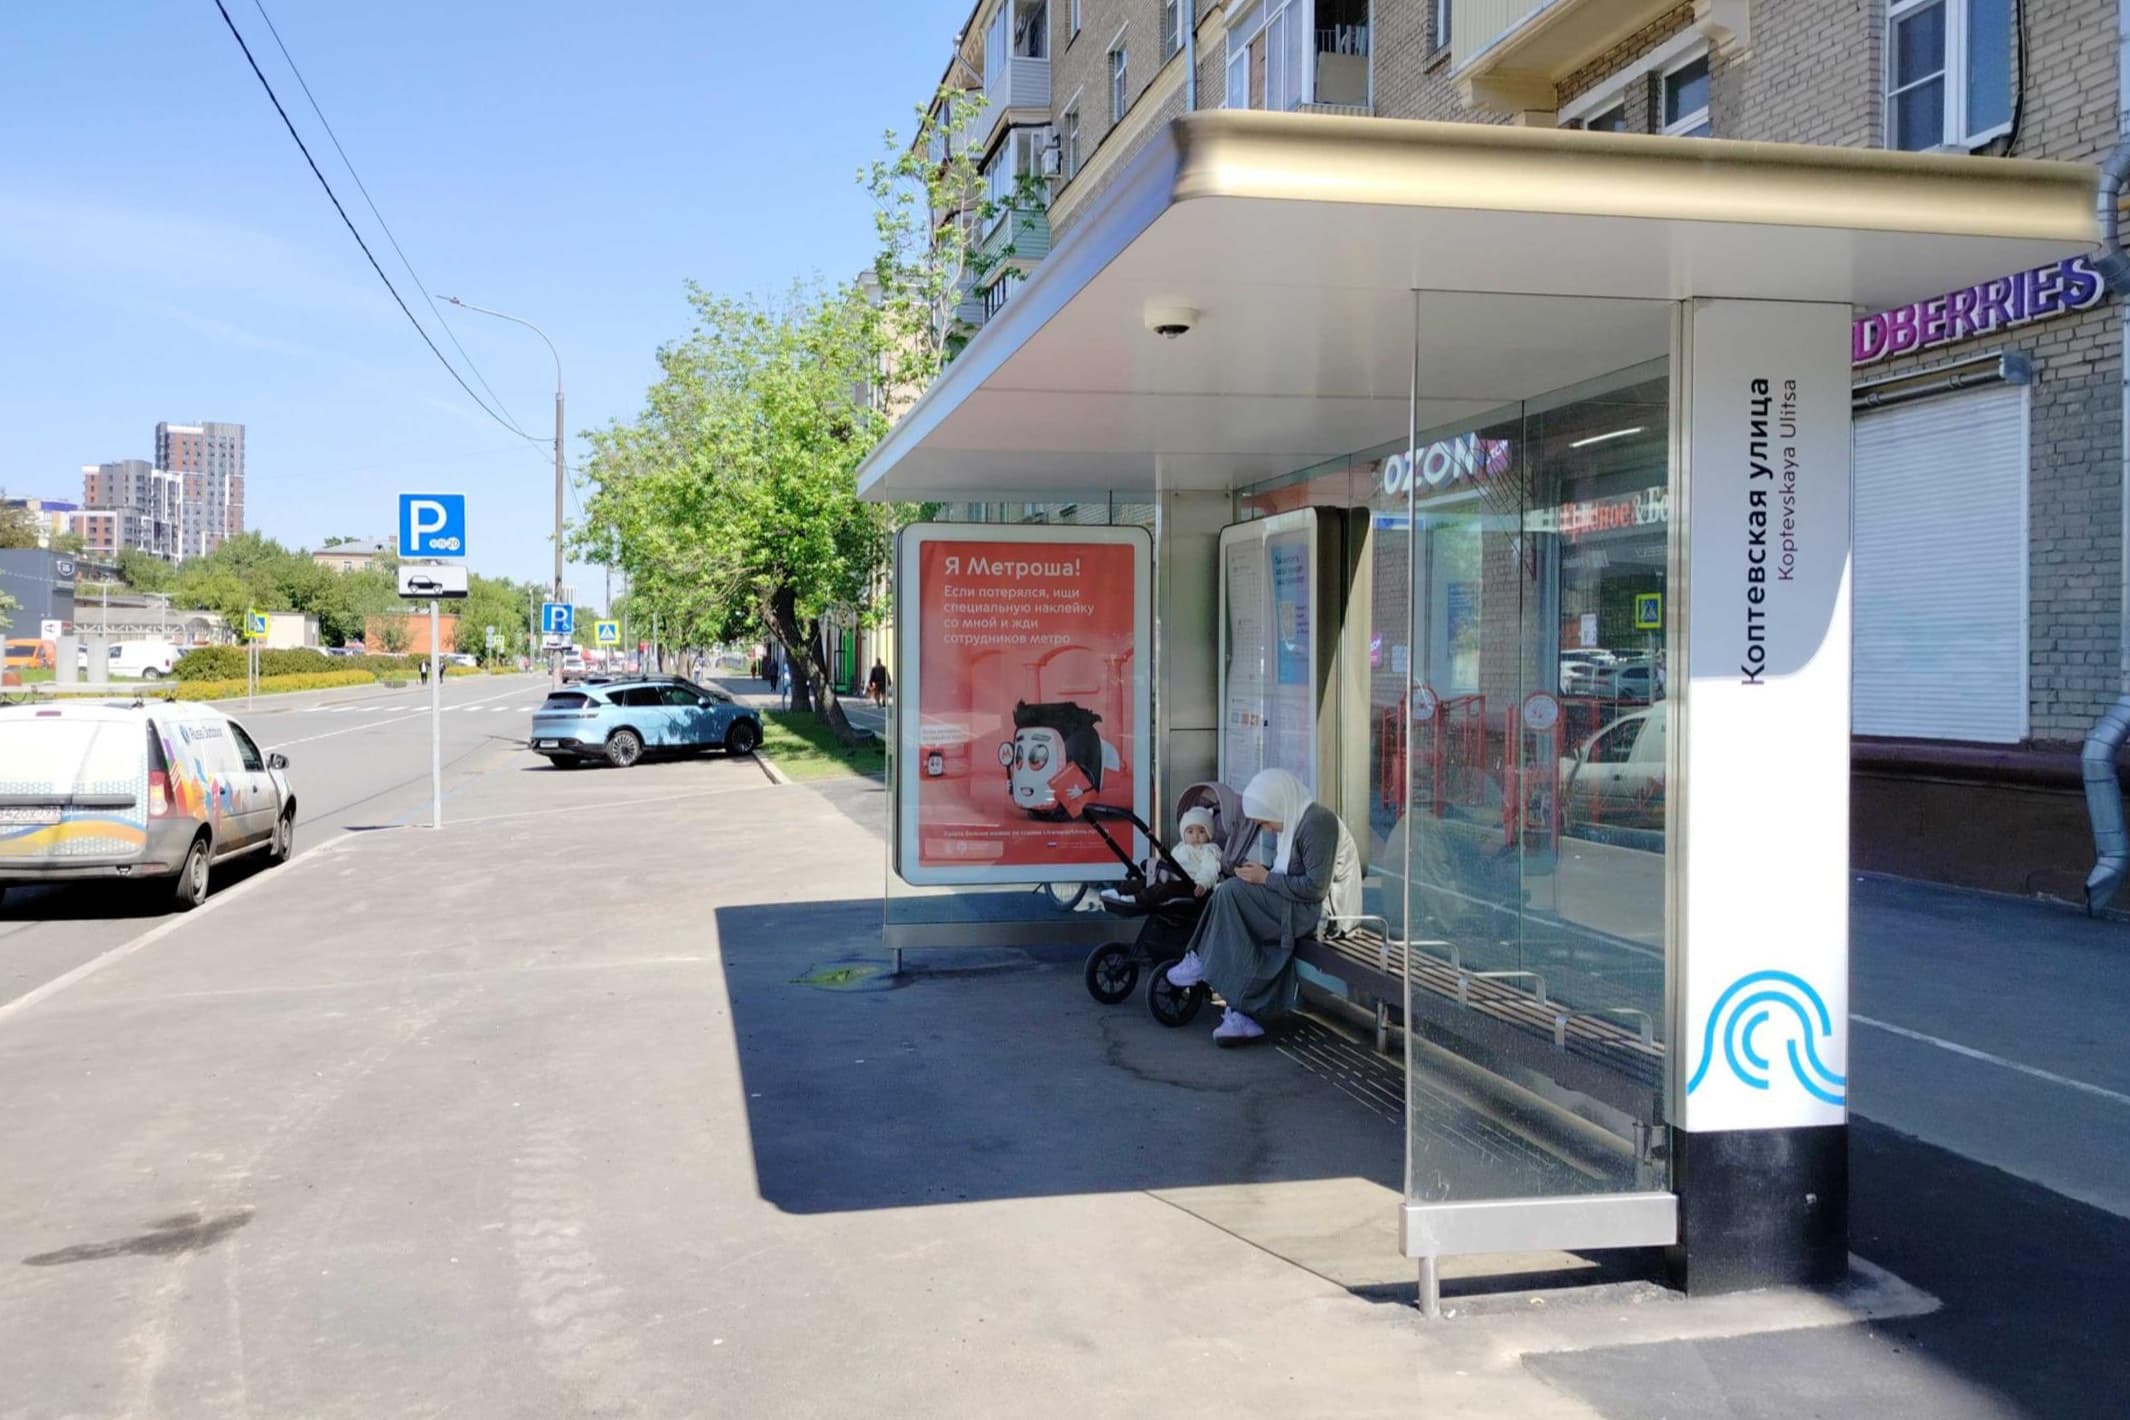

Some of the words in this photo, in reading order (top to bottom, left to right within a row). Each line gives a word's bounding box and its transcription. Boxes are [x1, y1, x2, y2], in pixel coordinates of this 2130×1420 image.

[1853, 255, 2104, 367] DBERRIES
[1750, 378, 1773, 480] улица
[1779, 379, 1796, 438] Ulitsa
[1384, 432, 1476, 495] OZON
[410, 500, 447, 551] P
[1778, 447, 1799, 580] Koptevskaya
[944, 585, 976, 598] Если
[979, 587, 1049, 602] потерялся,
[1053, 588, 1080, 600] ищи
[945, 556, 960, 575] Я
[967, 557, 1081, 580] Метроша!
[1741, 490, 1767, 685] Коптевская
[943, 603, 1032, 616] специальную
[1035, 602, 1095, 616] наклейку
[943, 619, 959, 629] со
[962, 616, 997, 629] мной
[1000, 619, 1009, 628] и
[1012, 619, 1039, 630] жди
[943, 634, 1027, 647] сотрудников
[1030, 634, 1071, 646] метро
